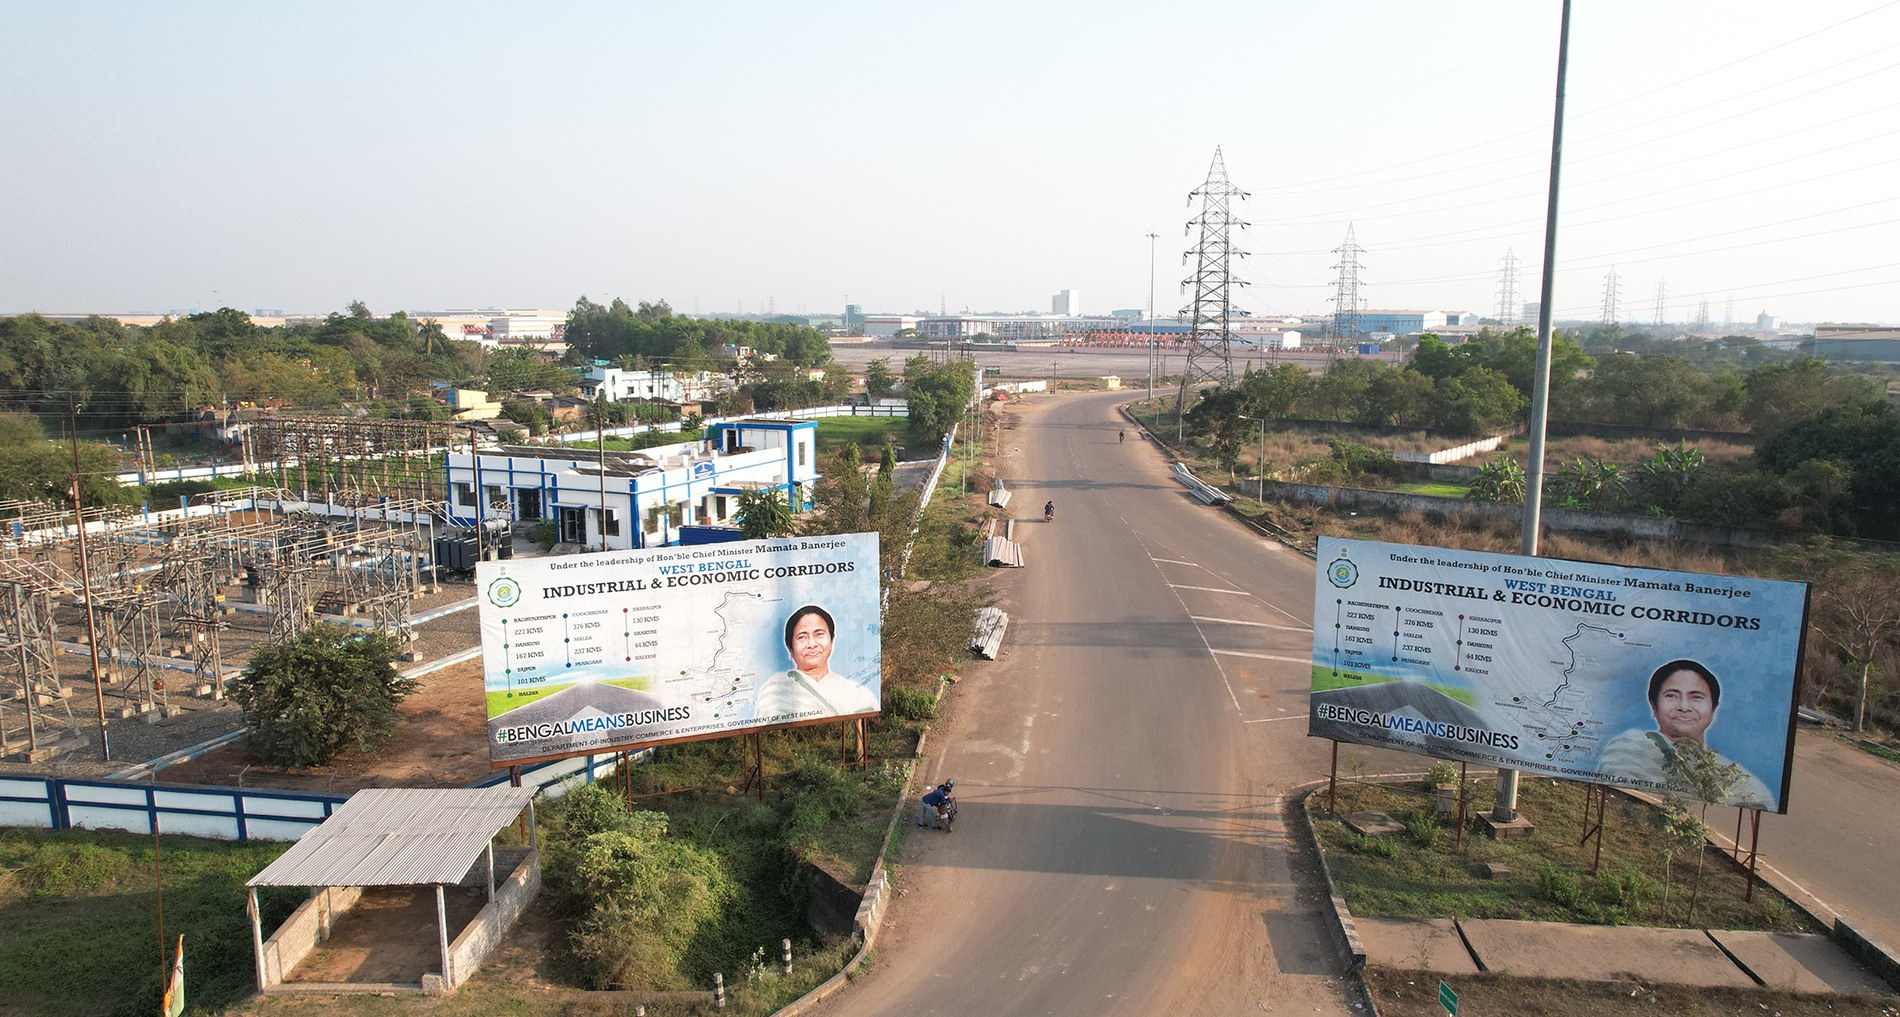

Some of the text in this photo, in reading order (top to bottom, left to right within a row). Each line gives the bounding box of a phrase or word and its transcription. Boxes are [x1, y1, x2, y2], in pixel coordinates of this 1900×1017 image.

[596, 557, 644, 567] leadership
[657, 553, 690, 562] Hon'ble
[692, 550, 716, 558] Chief
[718, 548, 753, 556] Minister
[756, 543, 798, 554] Mamata
[801, 540, 846, 551] Banerjee
[659, 559, 751, 575] WEST BENGAL
[543, 561, 855, 599] INDUSTRIAL & ECONOMIC CORRIDORS
[1390, 554, 1751, 599] Under the leadership of Hon'ble Chief Minister Mamata Banerjee
[1504, 579, 1616, 601] WEST BENGAL
[1379, 576, 1761, 631] INDUSTRIAL & ECONOMIC CORRIDORS
[1480, 629, 1498, 637] KMS
[1475, 654, 1492, 662] KMS
[497, 706, 690, 743] #BENGALMEANSBUSINESS
[542, 741, 588, 753] DEPARTMENT
[636, 730, 674, 739] COMMERCE
[681, 723, 726, 734] ENTERPRISES,
[728, 717, 770, 727] GOVERNMENT
[1318, 704, 1519, 750] #BENGALMEANSBUSINESS
[1359, 732, 1405, 746] DEPARTMENT
[1455, 750, 1497, 762] COMMERCE
[1506, 759, 1559, 773] ENTERPRISES,
[1561, 767, 1616, 782] GOVERNMENT
[1631, 779, 1653, 787] WEST
[1656, 783, 1690, 793] BENGAL
